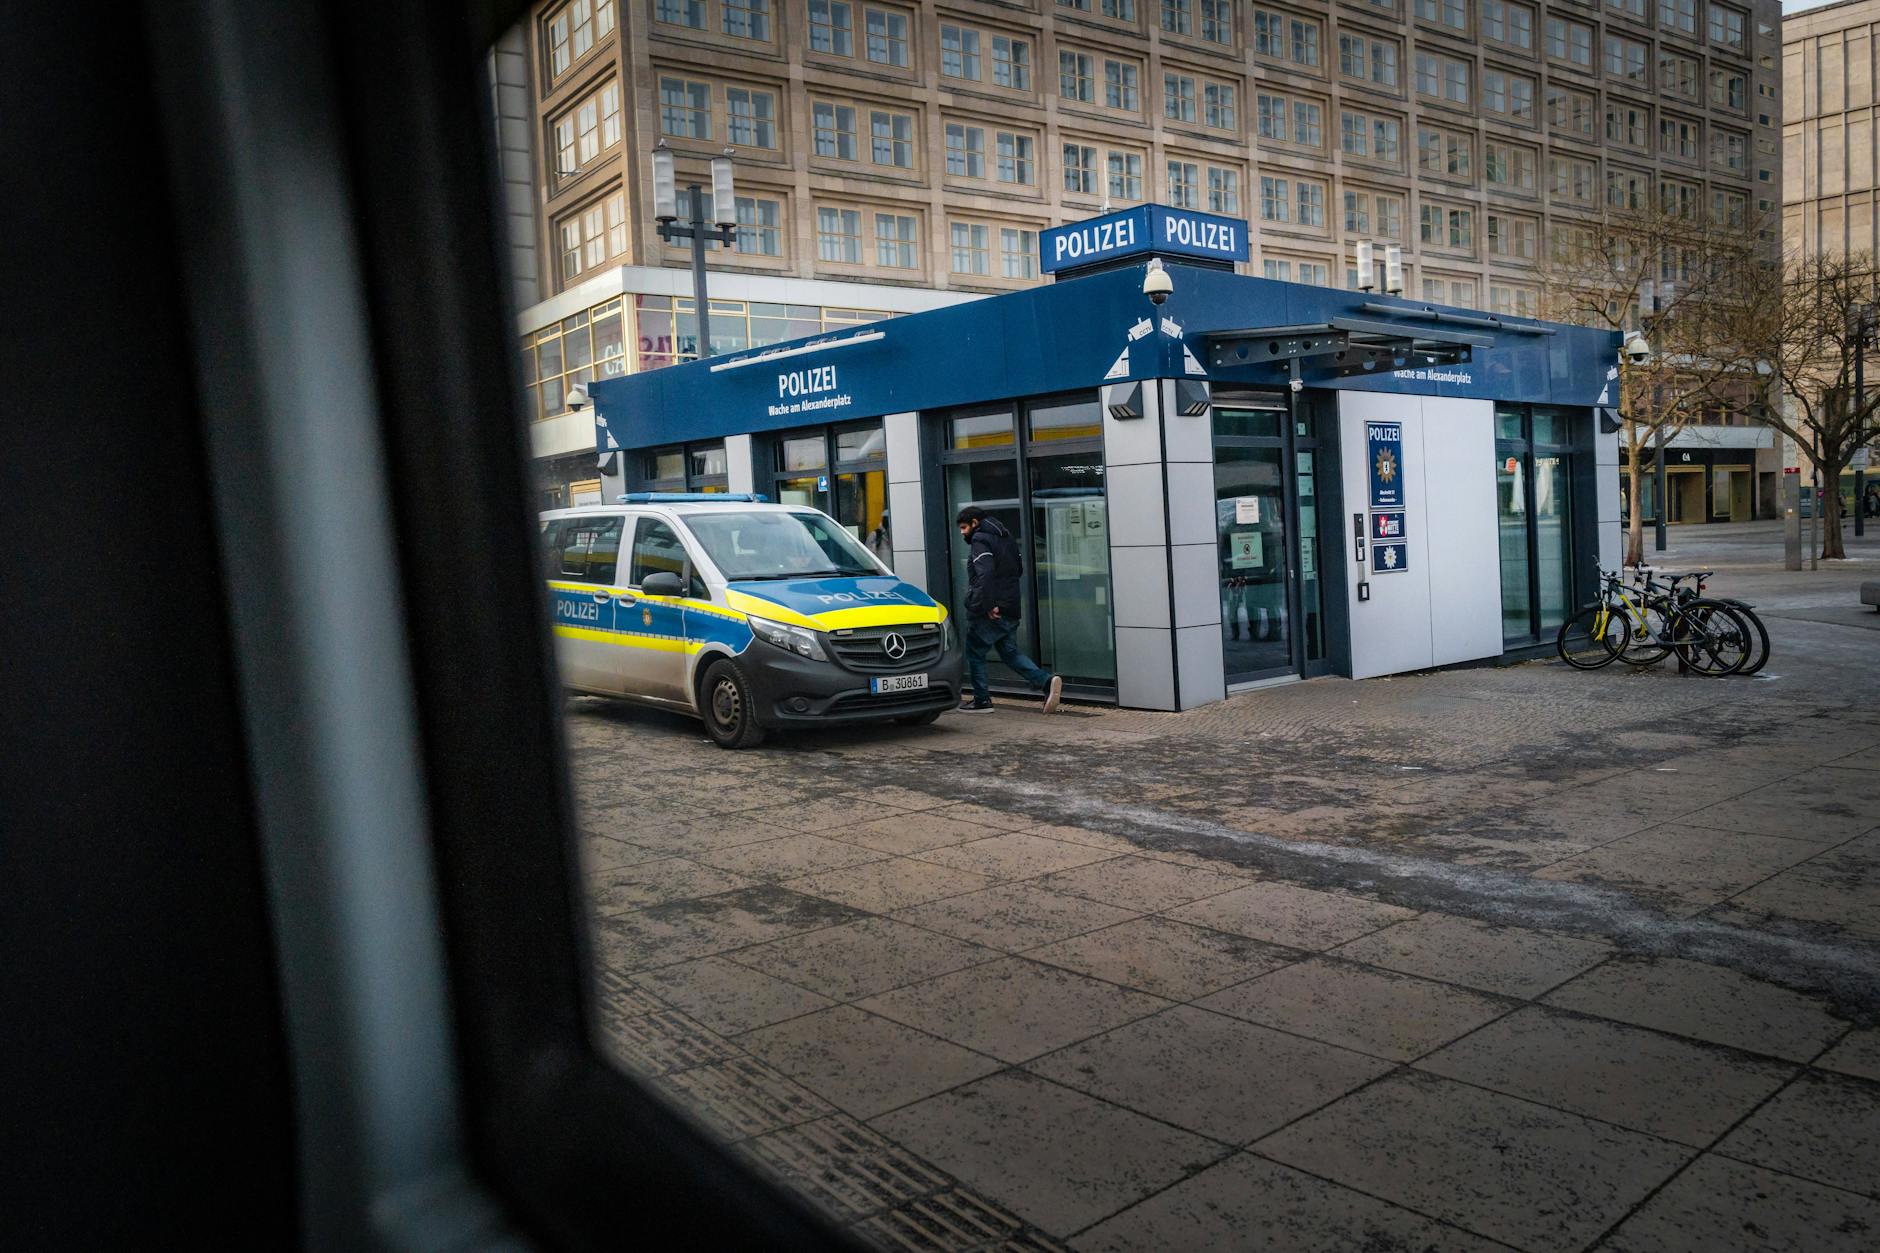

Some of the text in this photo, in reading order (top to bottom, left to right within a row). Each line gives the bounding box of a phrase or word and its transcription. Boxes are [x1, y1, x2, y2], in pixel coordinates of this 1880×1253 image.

[1055, 218, 1135, 261] POLIZEI
[1165, 216, 1236, 252] POLIZEI
[1139, 326, 1152, 336] CCTV
[778, 365, 837, 398] POLIZEI
[1416, 370, 1426, 380] am
[1427, 369, 1472, 386] Alexanderplatz
[768, 394, 852, 416] Wache am Alexanderplatz
[1369, 427, 1400, 442] POLIZEI
[817, 591, 907, 605] POLIZEI
[557, 600, 599, 621] POLIZEI
[882, 675, 923, 691] B 30861
